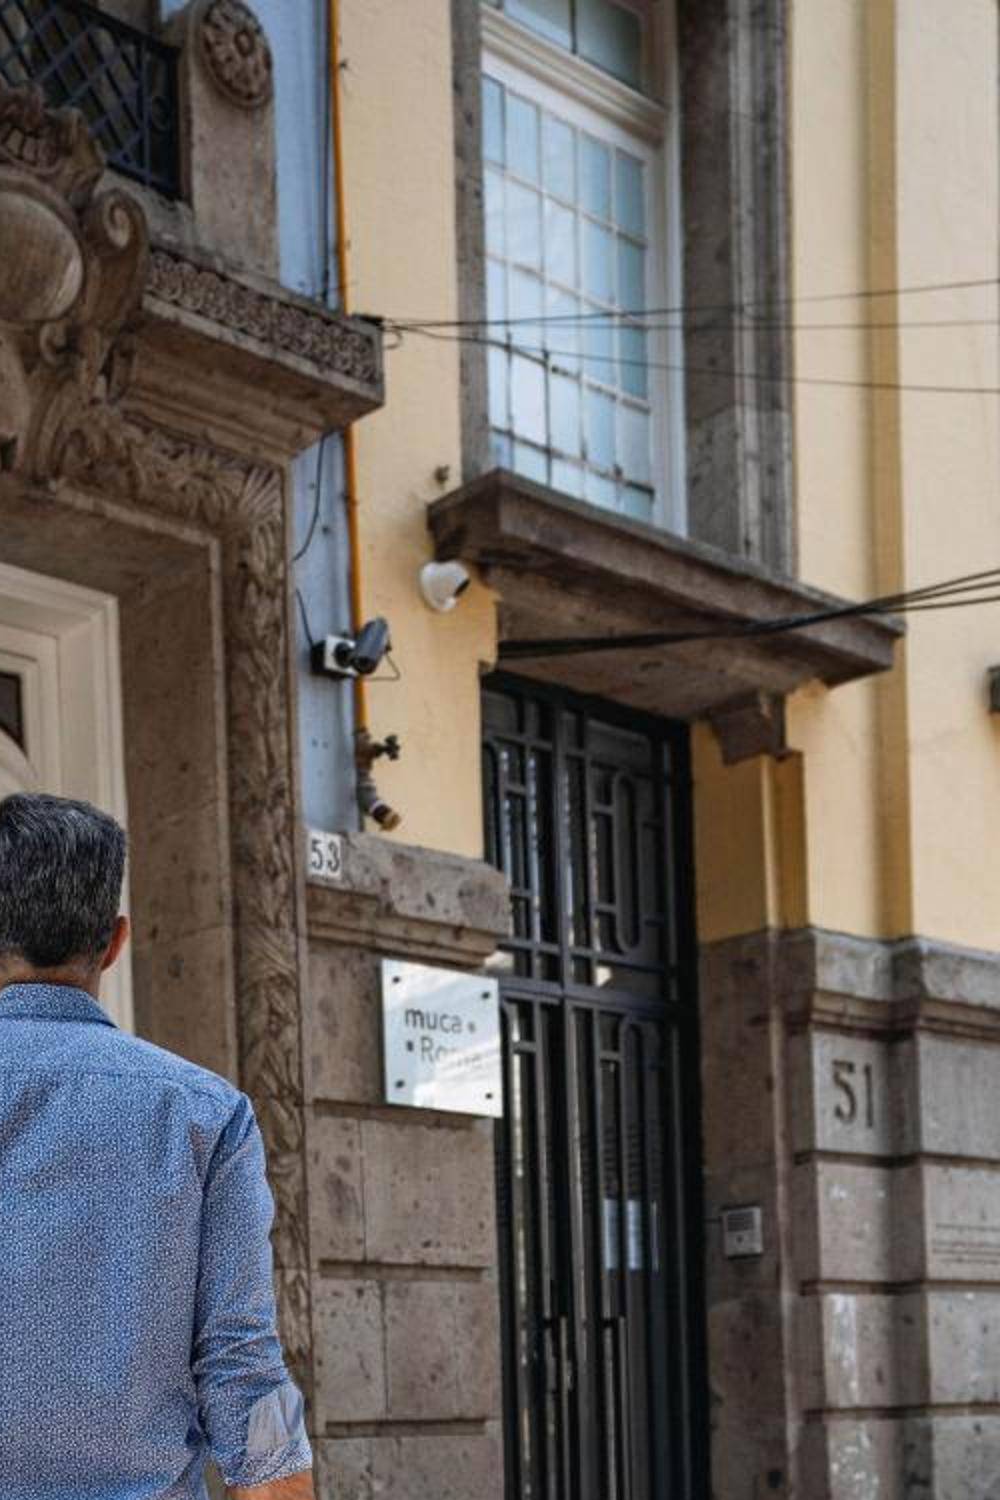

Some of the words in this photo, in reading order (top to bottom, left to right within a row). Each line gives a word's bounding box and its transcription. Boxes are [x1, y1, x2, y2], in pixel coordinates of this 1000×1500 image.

[310, 839, 341, 873] 53
[404, 1008, 462, 1034] muca
[831, 1059, 874, 1129] 51
